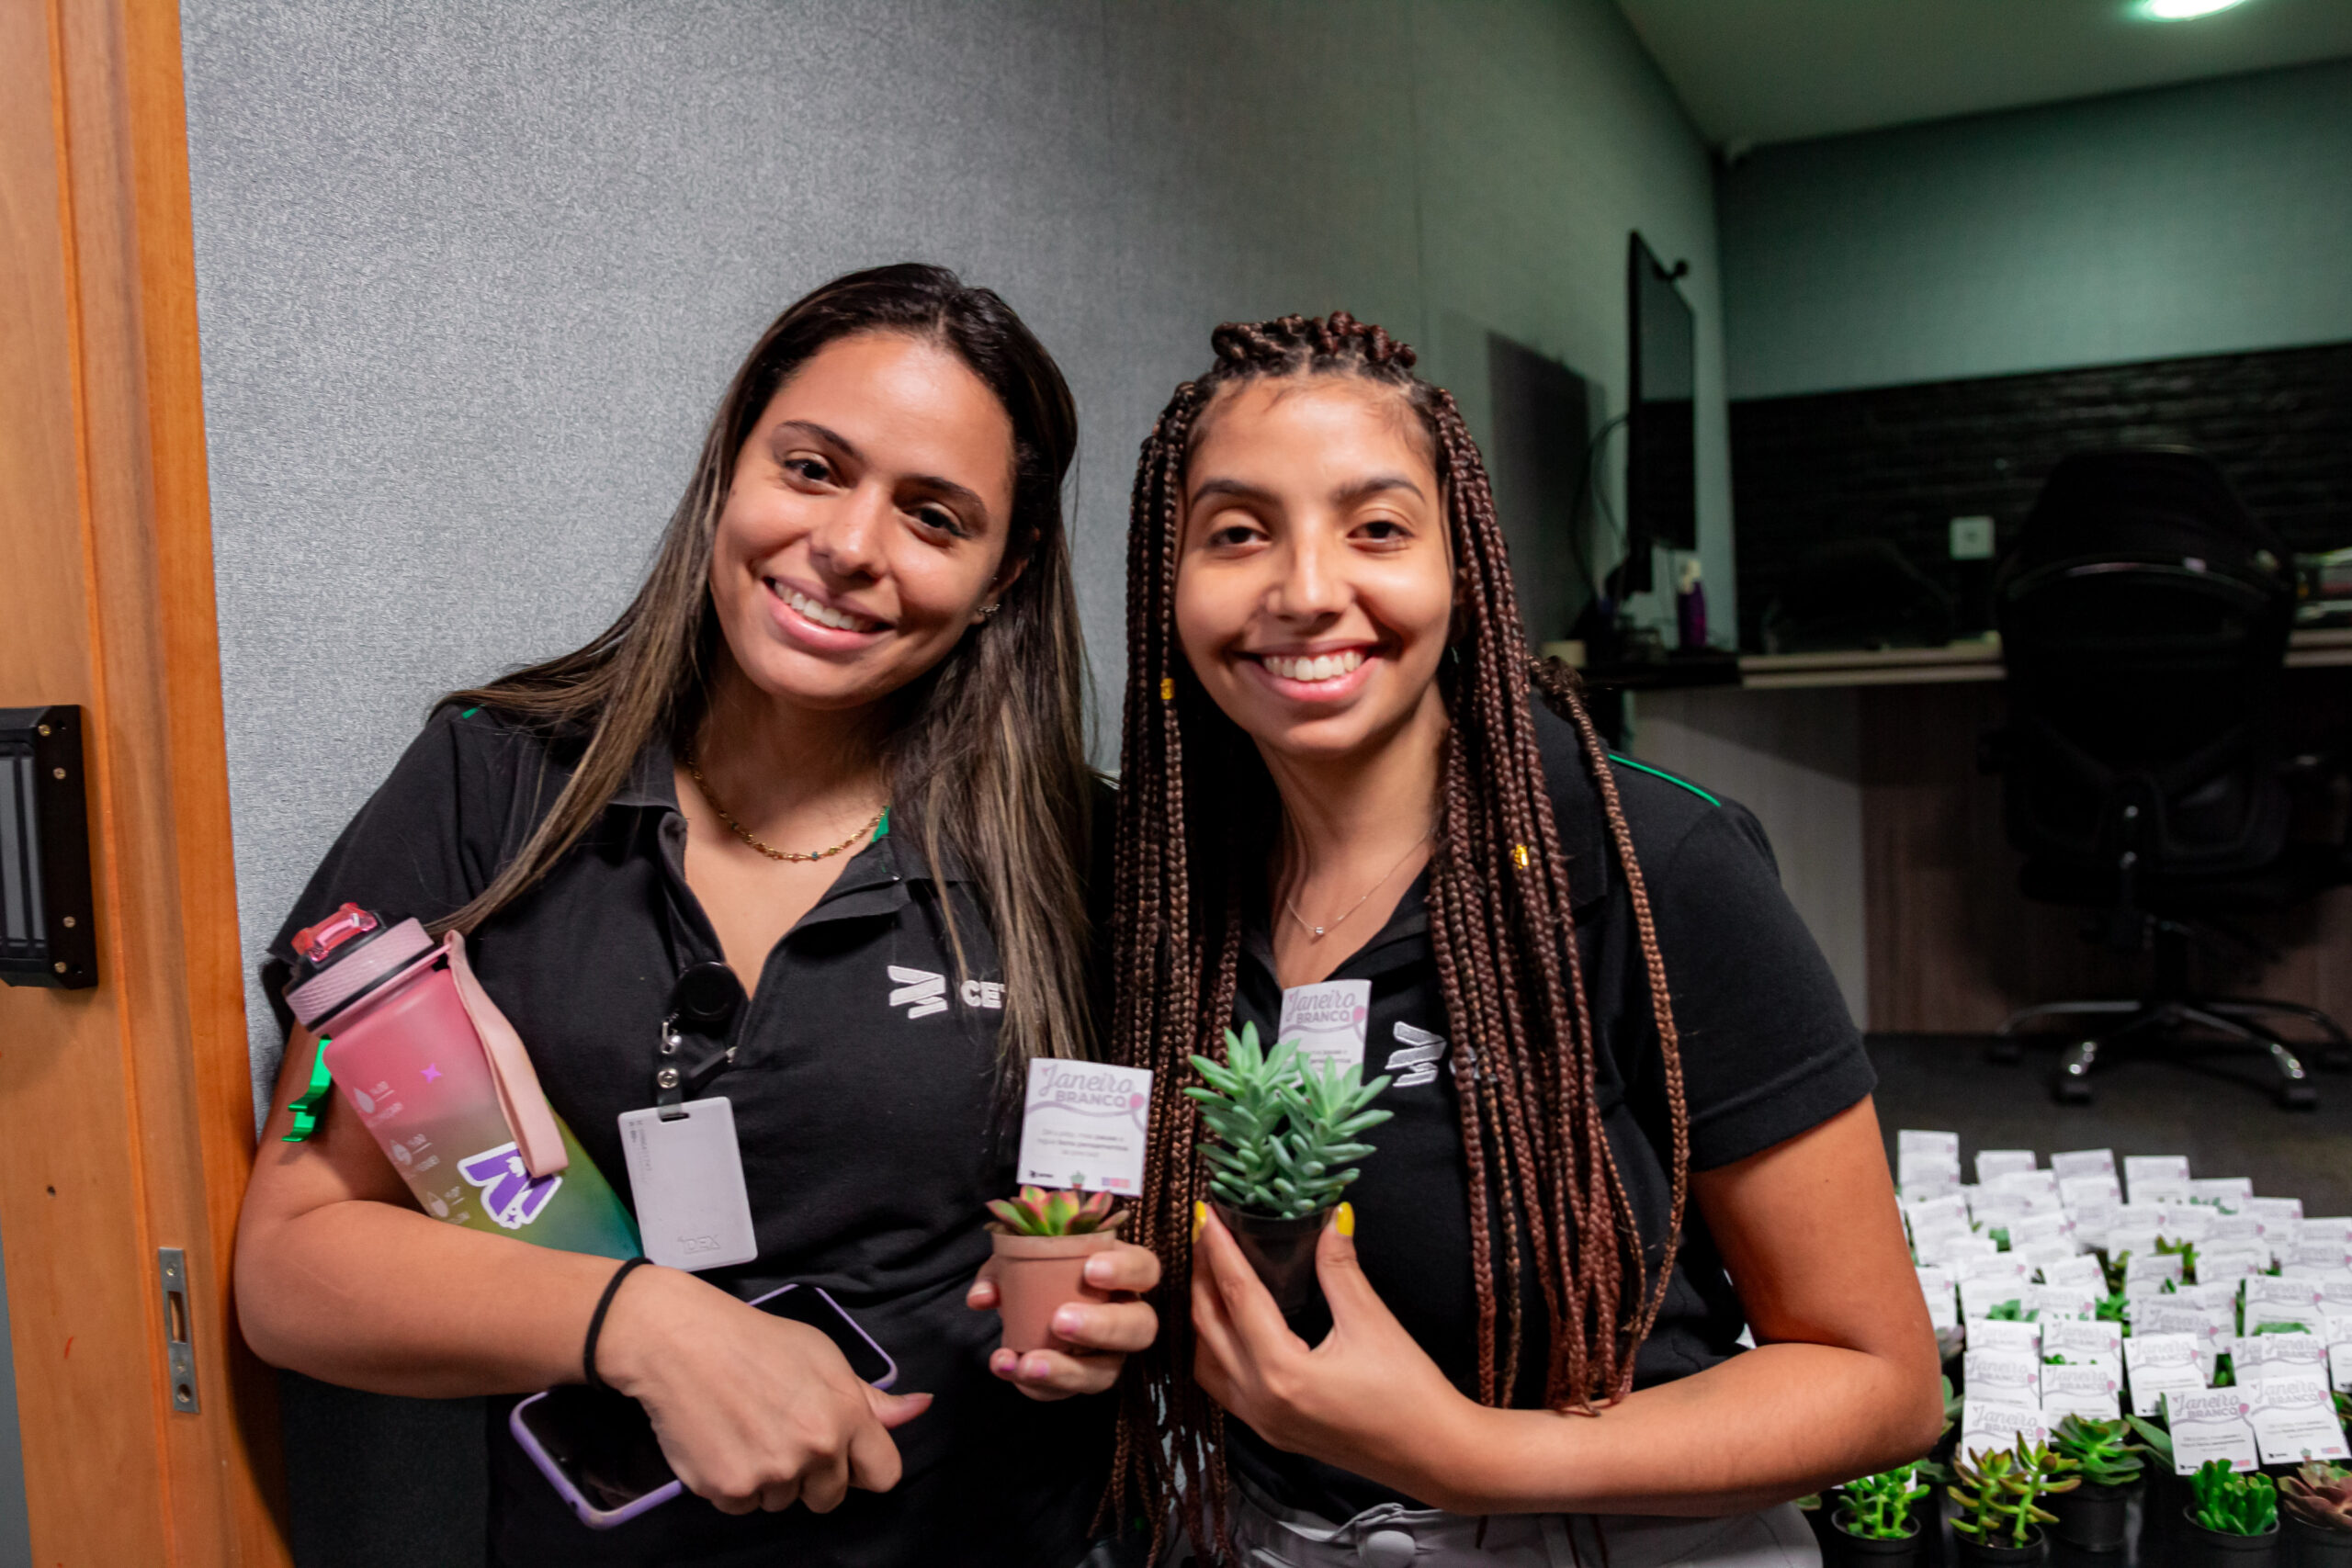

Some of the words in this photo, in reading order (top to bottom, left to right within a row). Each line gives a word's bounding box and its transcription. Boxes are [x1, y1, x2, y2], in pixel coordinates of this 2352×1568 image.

[960, 979, 1007, 1010] CE
[1286, 988, 1356, 1022] Janeiro
[1296, 1009, 1351, 1024] BRANCO
[1038, 1064, 1134, 1097] Janeiro
[1056, 1089, 1126, 1108] BRANCO
[2251, 1380, 2318, 1404] Janeiro
[2268, 1393, 2318, 1405] BRANCO
[1973, 1404, 2038, 1427] Janeiro
[2172, 1392, 2240, 1417] Janeiro
[2187, 1406, 2239, 1419] BRANCO
